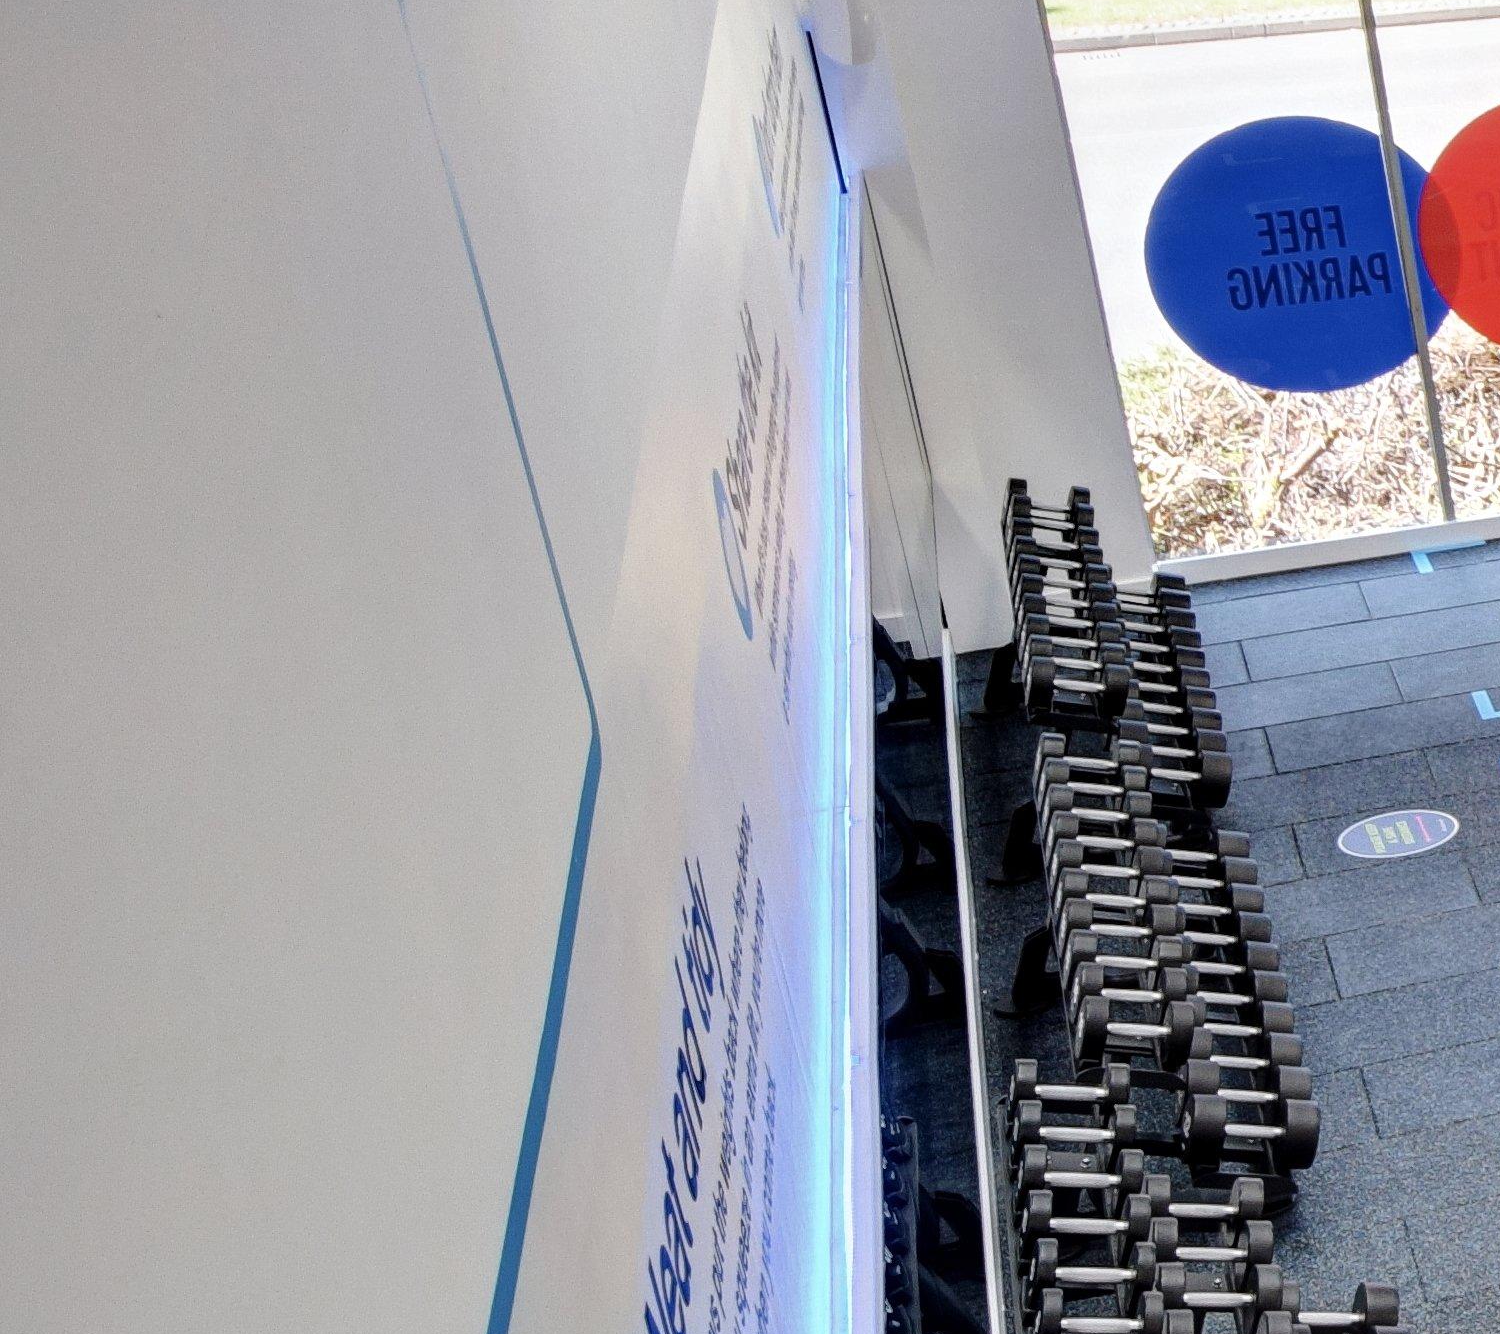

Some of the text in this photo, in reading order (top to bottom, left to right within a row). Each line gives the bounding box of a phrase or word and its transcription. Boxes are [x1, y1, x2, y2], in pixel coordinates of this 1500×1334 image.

[682, 855, 726, 1034] tidy
[673, 954, 706, 1202] and
[716, 1056, 738, 1210] weights
[709, 1224, 727, 1317] put
[712, 1165, 727, 1246] the
